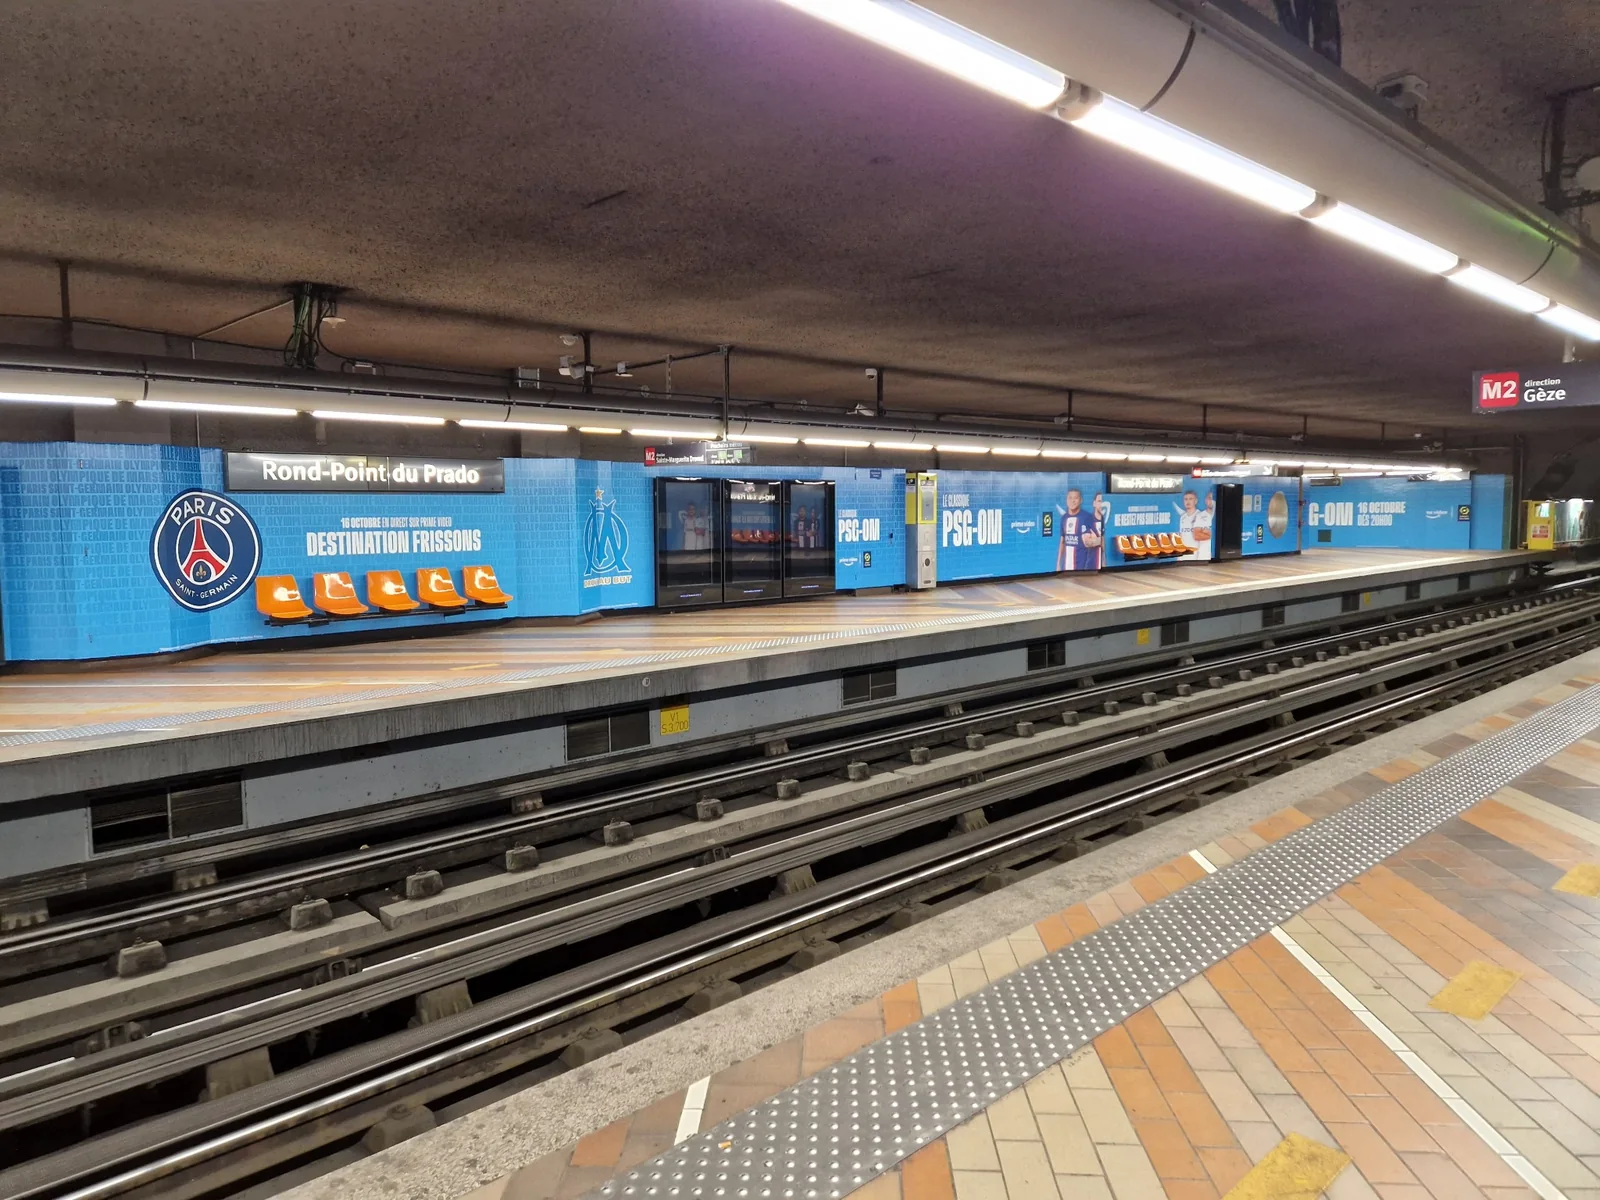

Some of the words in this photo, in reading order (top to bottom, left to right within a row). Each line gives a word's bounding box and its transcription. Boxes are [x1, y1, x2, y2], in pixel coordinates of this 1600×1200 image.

[1482, 380, 1517, 400] M2
[1524, 378, 1561, 387] direction
[1523, 388, 1567, 403] Gèze
[645, 451, 656, 461] M2
[262, 461, 387, 482] Rond-Point
[392, 463, 418, 483] du
[423, 464, 480, 484] Prado
[943, 494, 948, 507] LE
[1357, 502, 1368, 514] 16
[1369, 502, 1406, 514] OCTOBRE
[170, 498, 235, 526] PARIS
[341, 517, 350, 529] 16
[351, 517, 381, 528] OCTOBRE
[390, 517, 408, 528] DIRECT
[409, 517, 419, 527] SUR
[420, 517, 436, 527] PRIME
[437, 516, 452, 527] VIDEO
[942, 509, 1002, 548] PSG-OM
[838, 518, 880, 543] PSG-OM
[306, 530, 409, 557] DESTINATION
[412, 529, 482, 553] FRISSONS
[612, 575, 632, 585] BUT
